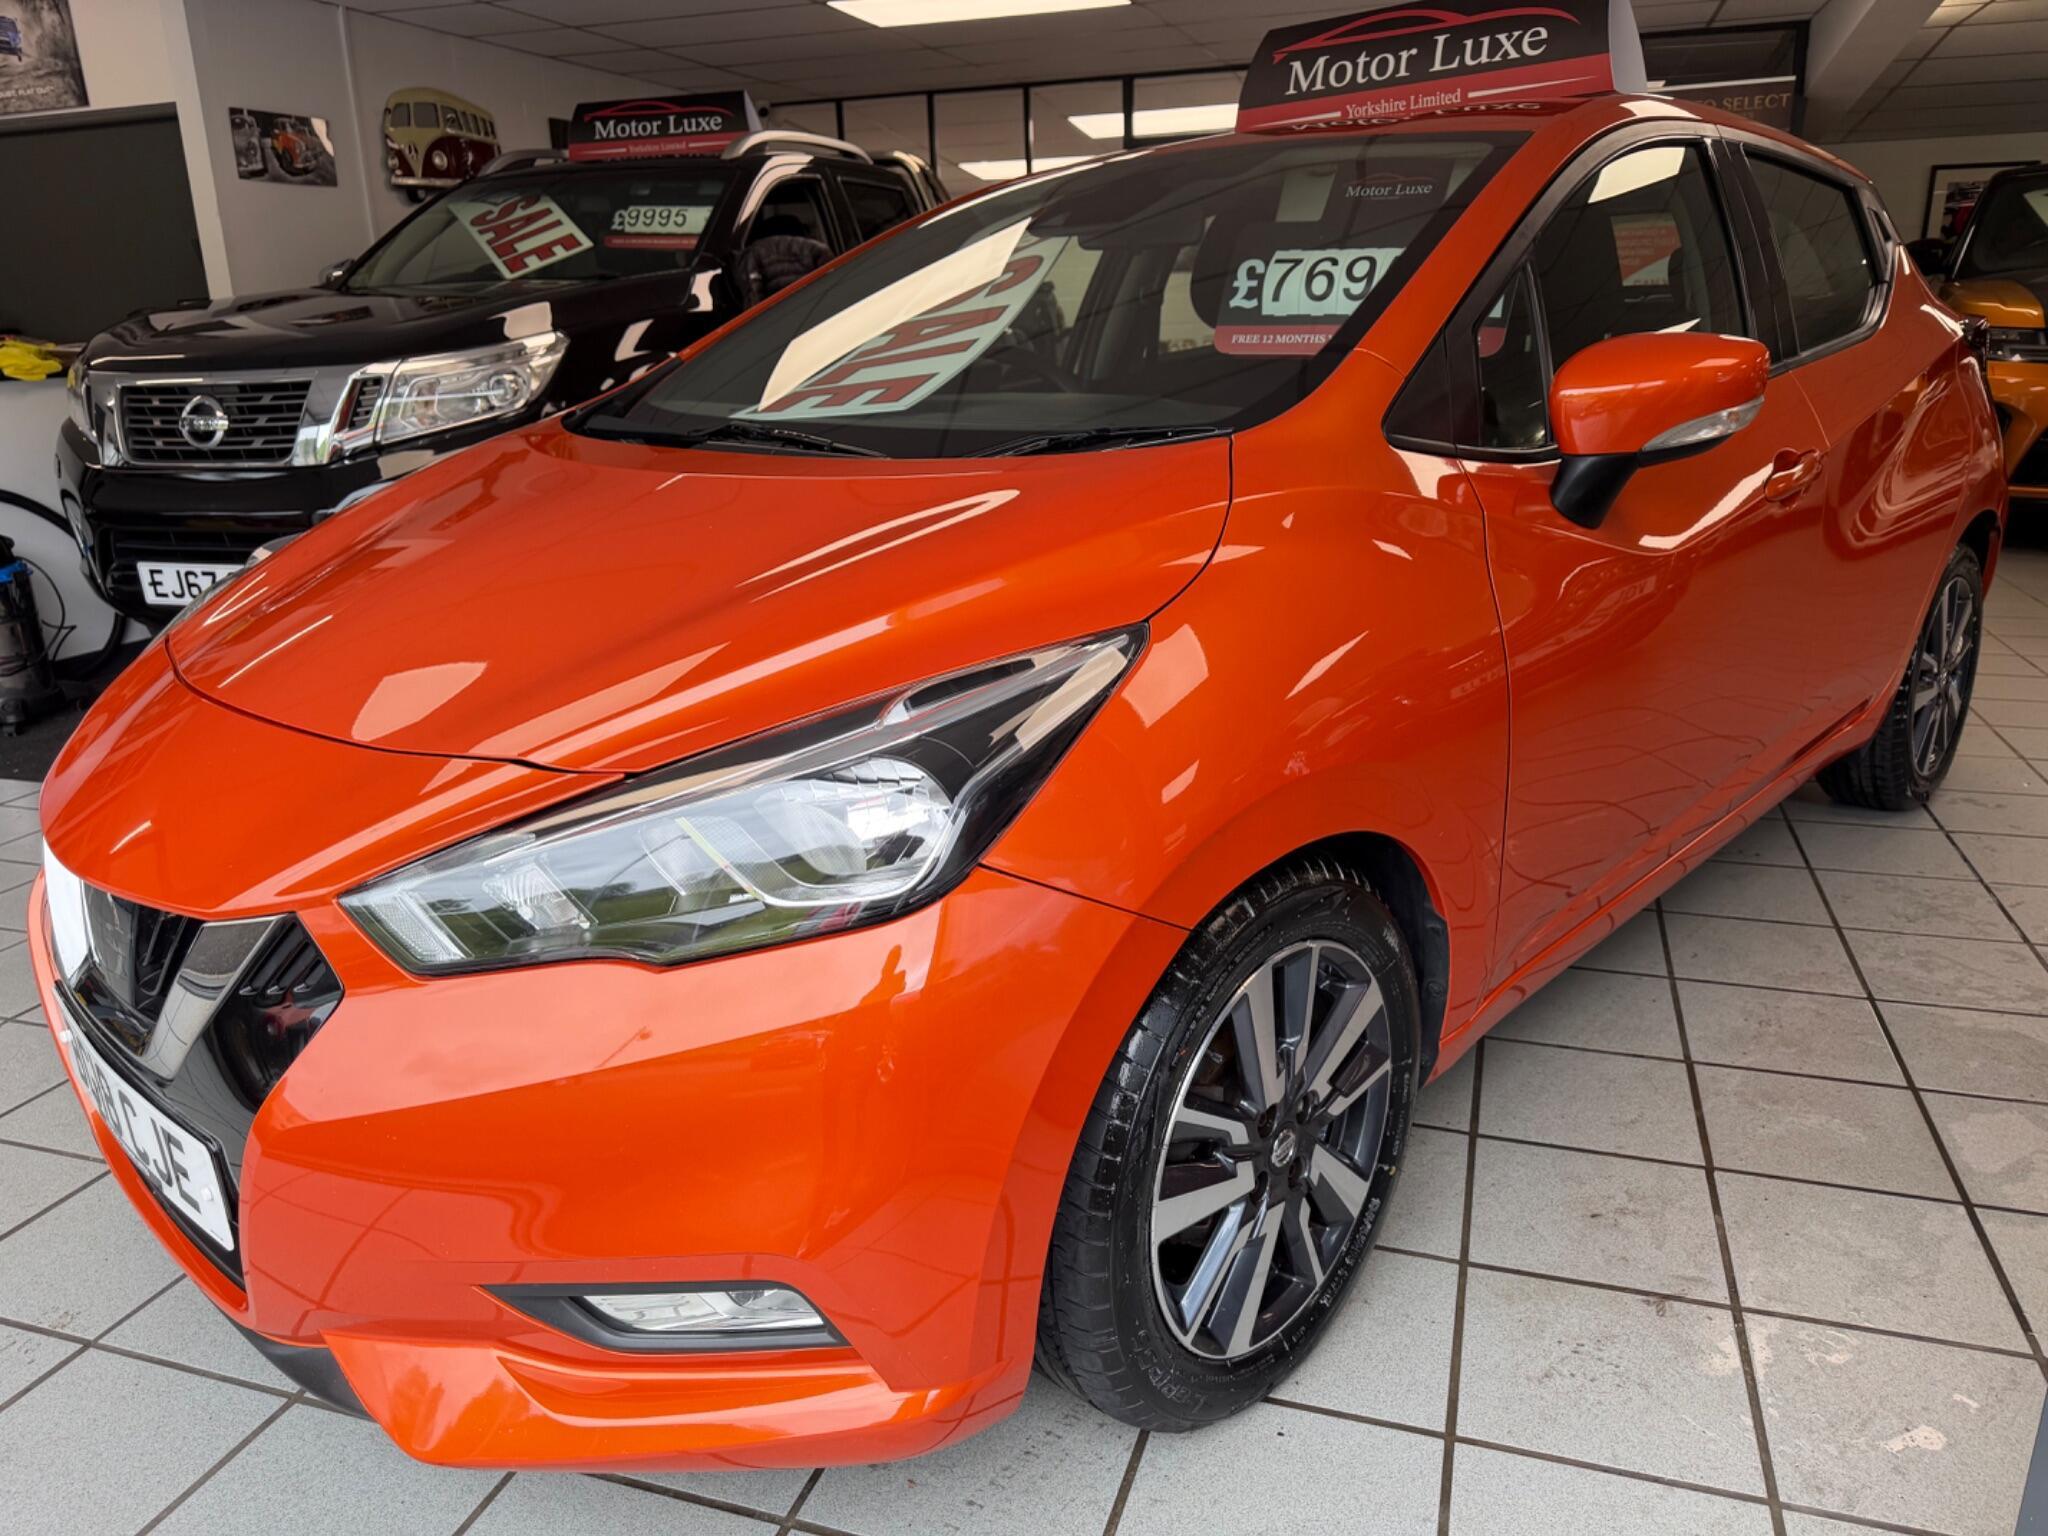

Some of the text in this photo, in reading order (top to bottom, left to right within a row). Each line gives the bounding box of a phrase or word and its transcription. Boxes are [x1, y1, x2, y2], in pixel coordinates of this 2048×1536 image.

[1284, 25, 1549, 97] Motor Luxe
[1345, 88, 1462, 119] Yorkshire Limited
[1721, 92, 1792, 112] SELECT
[593, 114, 723, 140] Motor Luxe
[1346, 183, 1433, 198] Motor Luxe
[610, 207, 688, 230] £9995
[470, 194, 582, 274] SALE
[1231, 334, 1261, 345] FREE
[1262, 334, 1274, 345] 12
[1275, 334, 1327, 345] MONTHS
